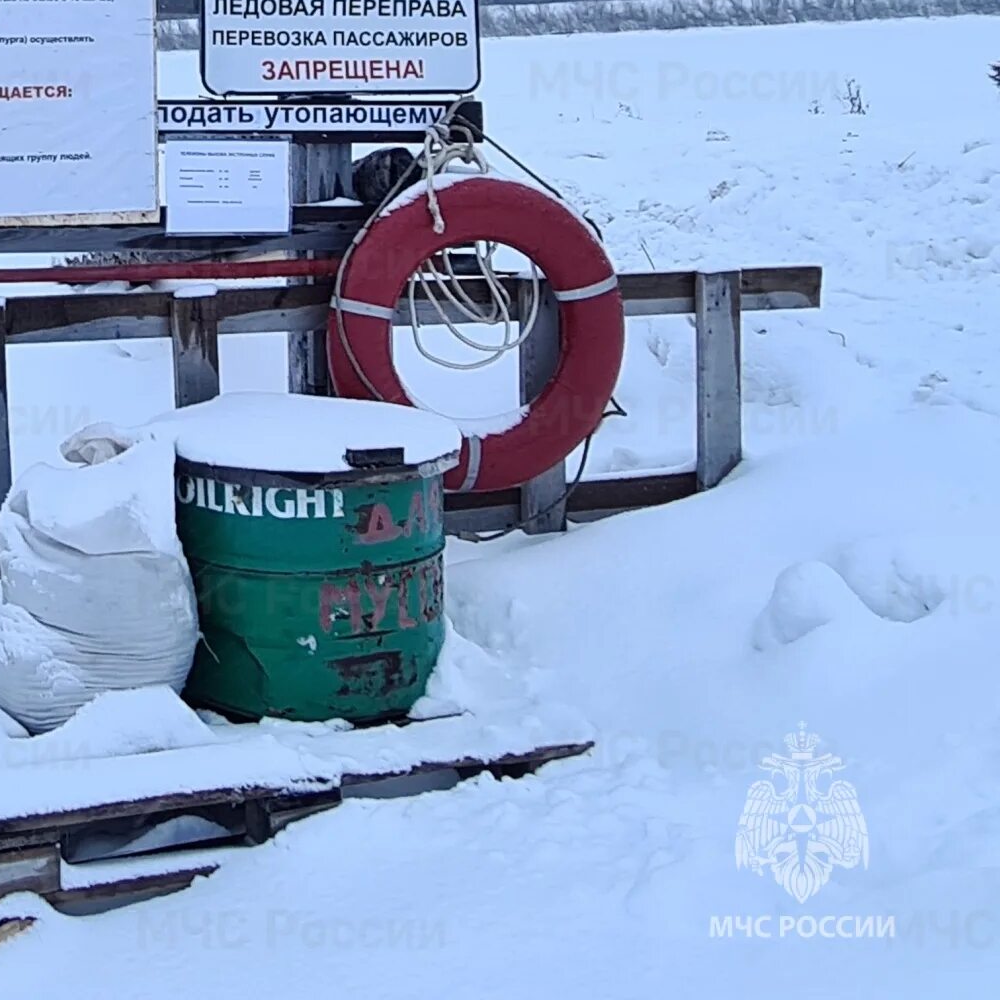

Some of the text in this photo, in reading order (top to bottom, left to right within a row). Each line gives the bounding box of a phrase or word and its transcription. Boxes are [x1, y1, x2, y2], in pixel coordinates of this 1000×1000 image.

[29, 36, 94, 45] осуществлять
[212, 30, 468, 47] ПЕРЕВОЗКА ПАССАЖИРОВ
[262, 59, 424, 83] ЗАПРЕЩЕНА!
[264, 105, 443, 129] утопающему
[26, 154, 58, 163] группу
[59, 152, 92, 162] людей.
